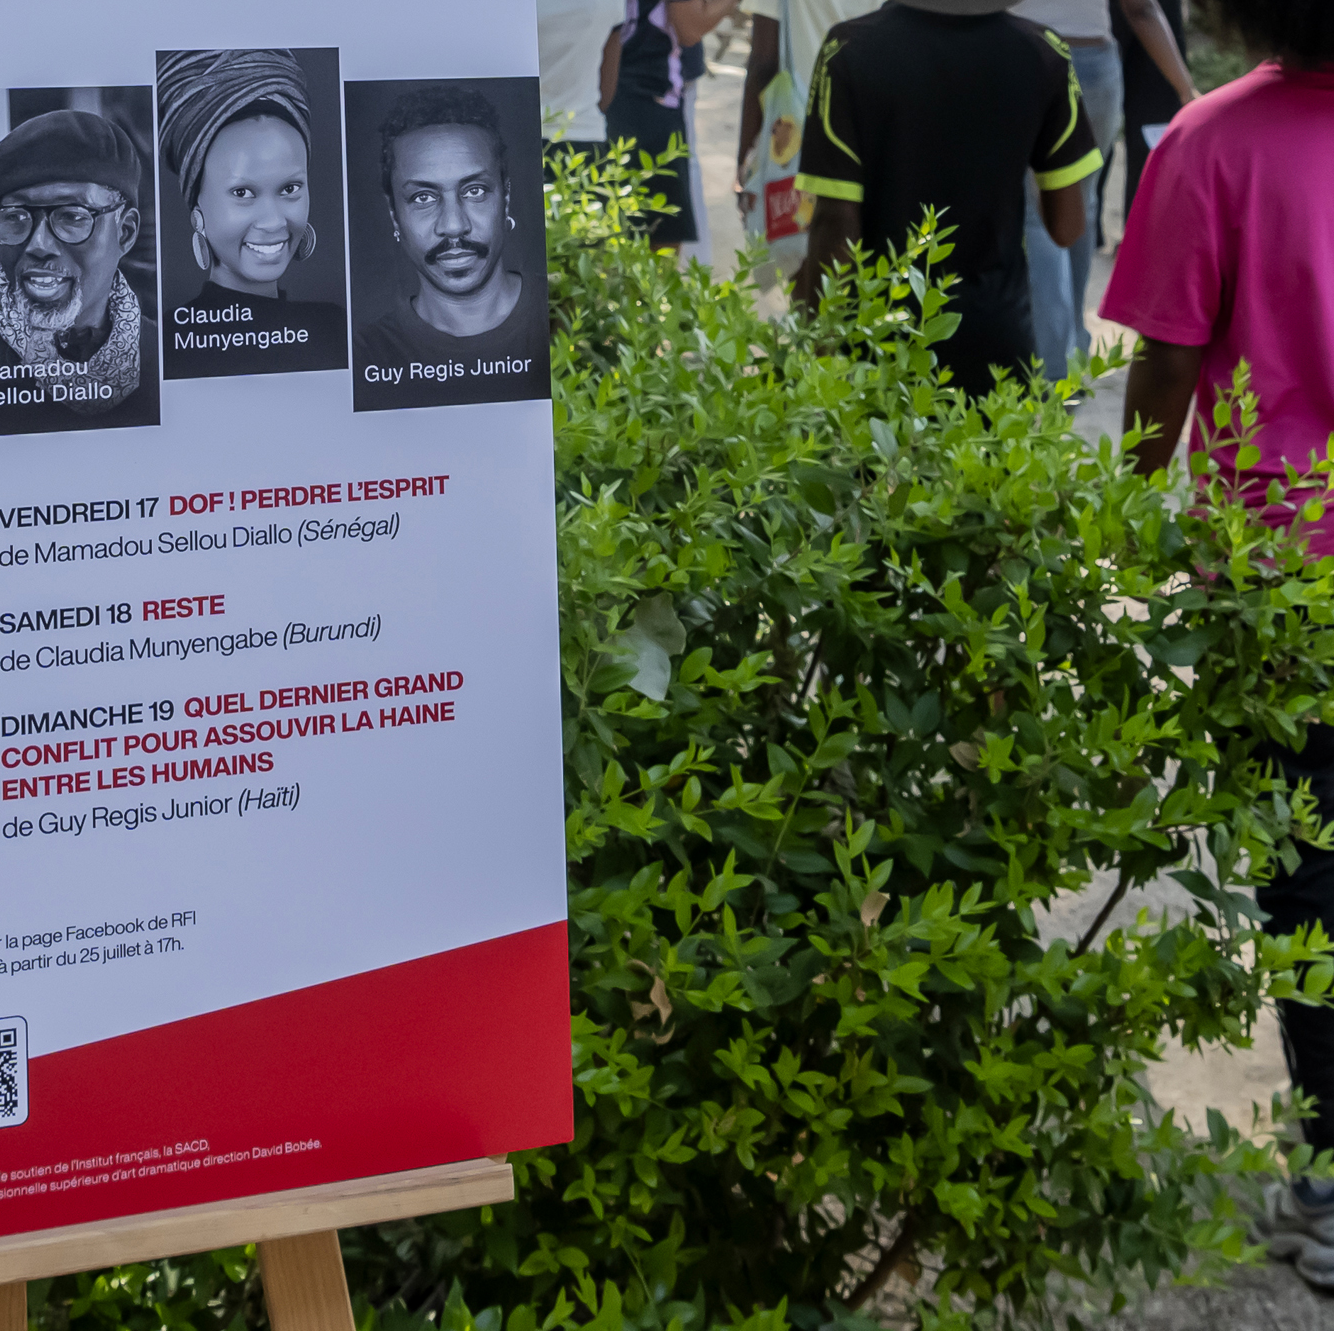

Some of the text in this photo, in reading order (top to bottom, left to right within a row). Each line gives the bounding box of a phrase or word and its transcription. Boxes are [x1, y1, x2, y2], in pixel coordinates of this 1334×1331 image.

[173, 304, 253, 326] Claudia
[173, 327, 309, 351] Munyengabe
[364, 356, 532, 385] Guy Regis Junior
[52, 382, 113, 402] Diallo
[136, 497, 159, 518] 17
[170, 493, 223, 515] DOF
[241, 484, 341, 510] PERDRE
[348, 475, 449, 501] L’ESPRIT
[0, 512, 399, 566] de Mamadou Sellou Diallo (Sénégal)
[0, 595, 225, 634] SAMEDI 18 RESTE
[0, 614, 381, 671] de Claudia Munyengabe (Burundi)
[2, 671, 463, 737] DIMANCHE 19 QUEL DERNIER GRAND
[2, 701, 454, 768] CONFLIT POUR ASSOUVIR LA HAINE
[3, 752, 273, 800] ENTRE LES HUMAINS
[3, 783, 299, 838] de Guy Regis Junior (Haïti)
[6, 935, 18, 949] la
[23, 932, 62, 950] page
[67, 918, 144, 941] Facebook
[148, 916, 168, 930] de
[172, 911, 195, 927] RFI
[11, 954, 52, 976] partir
[56, 951, 76, 966] du
[80, 947, 99, 963] 25
[103, 943, 141, 964] juillet
[144, 940, 153, 954] à
[157, 937, 185, 952] 17h.
[10, 1166, 52, 1180] soutien
[54, 1162, 69, 1173] de
[116, 1148, 161, 1163] français,
[163, 1146, 173, 1156] la
[175, 1139, 210, 1154] SACD,
[50, 1174, 109, 1191] supérieure
[138, 1159, 201, 1177] dramatique
[203, 1151, 250, 1167] direction
[252, 1144, 282, 1159] David
[285, 1139, 322, 1153] Bobée.
